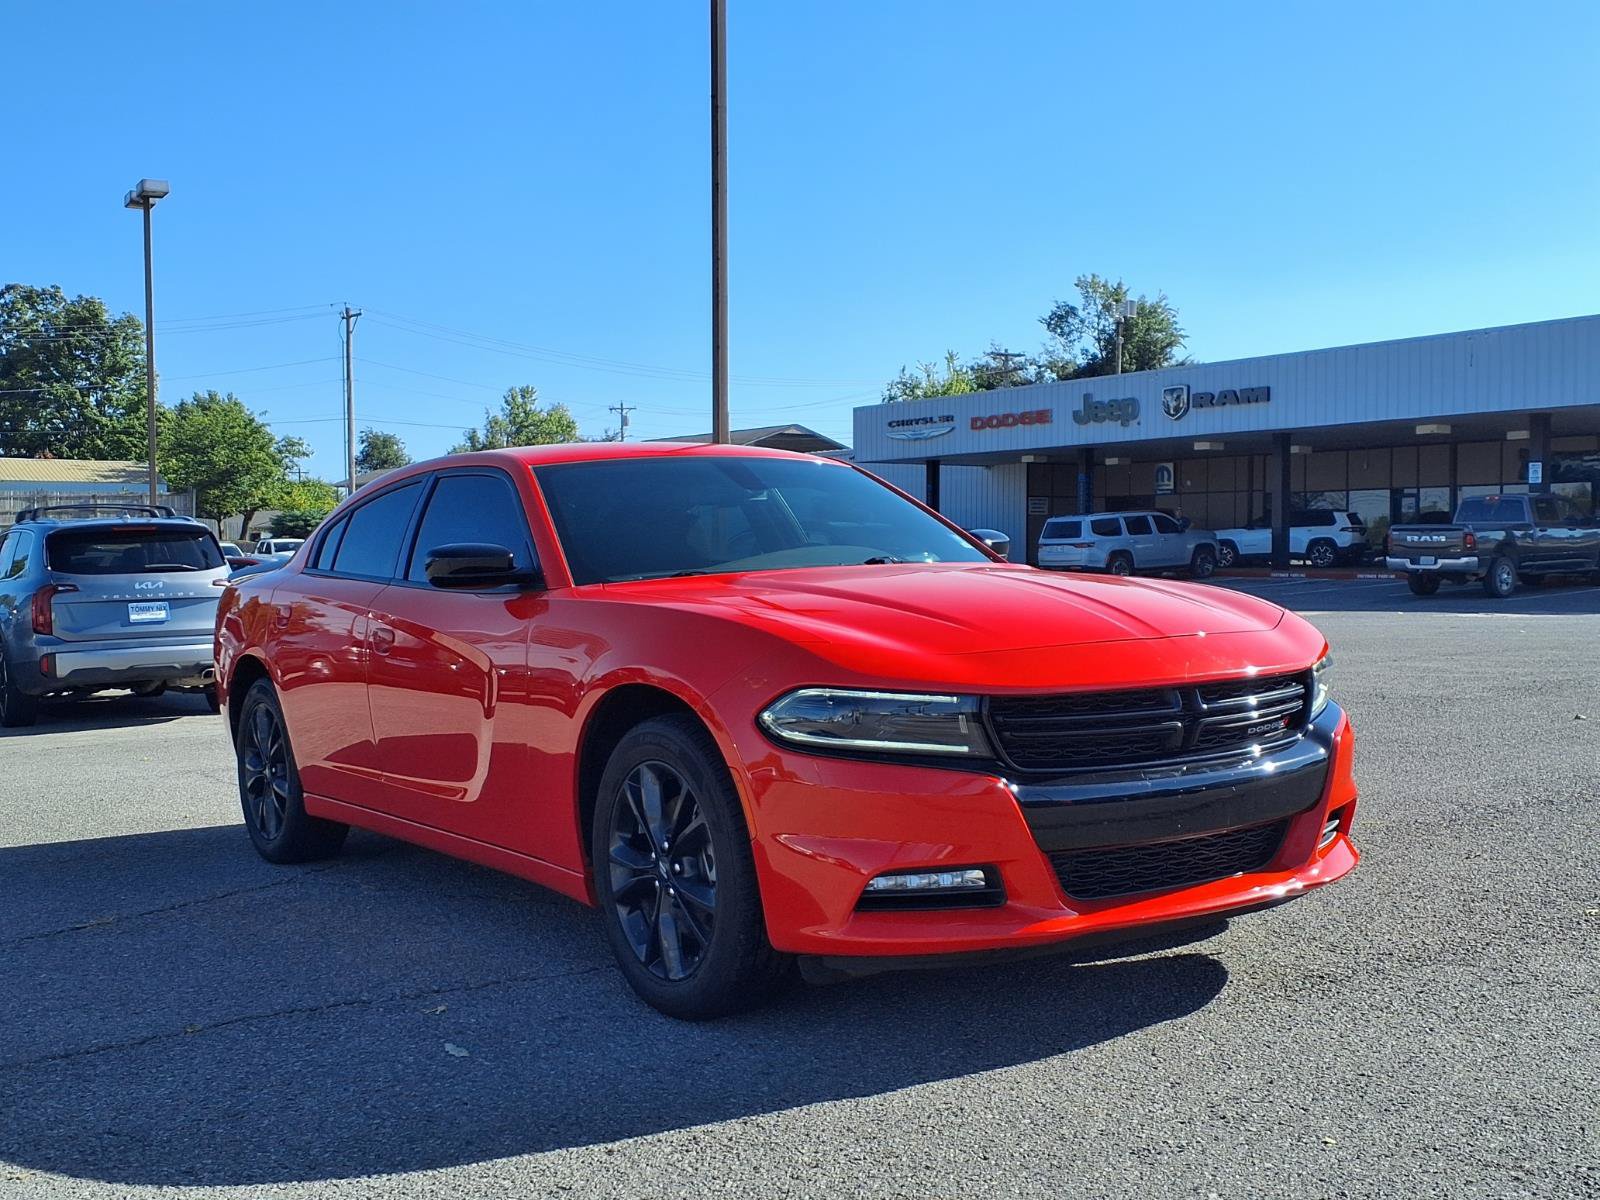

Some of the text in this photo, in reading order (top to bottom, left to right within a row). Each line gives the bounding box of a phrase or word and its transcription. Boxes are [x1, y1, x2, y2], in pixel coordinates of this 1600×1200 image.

[1192, 386, 1271, 408] RAM
[971, 409, 1053, 430] DODGE
[1072, 393, 1141, 427] Jeep
[888, 415, 954, 428] CHRYSLER
[1406, 534, 1447, 543] RAM
